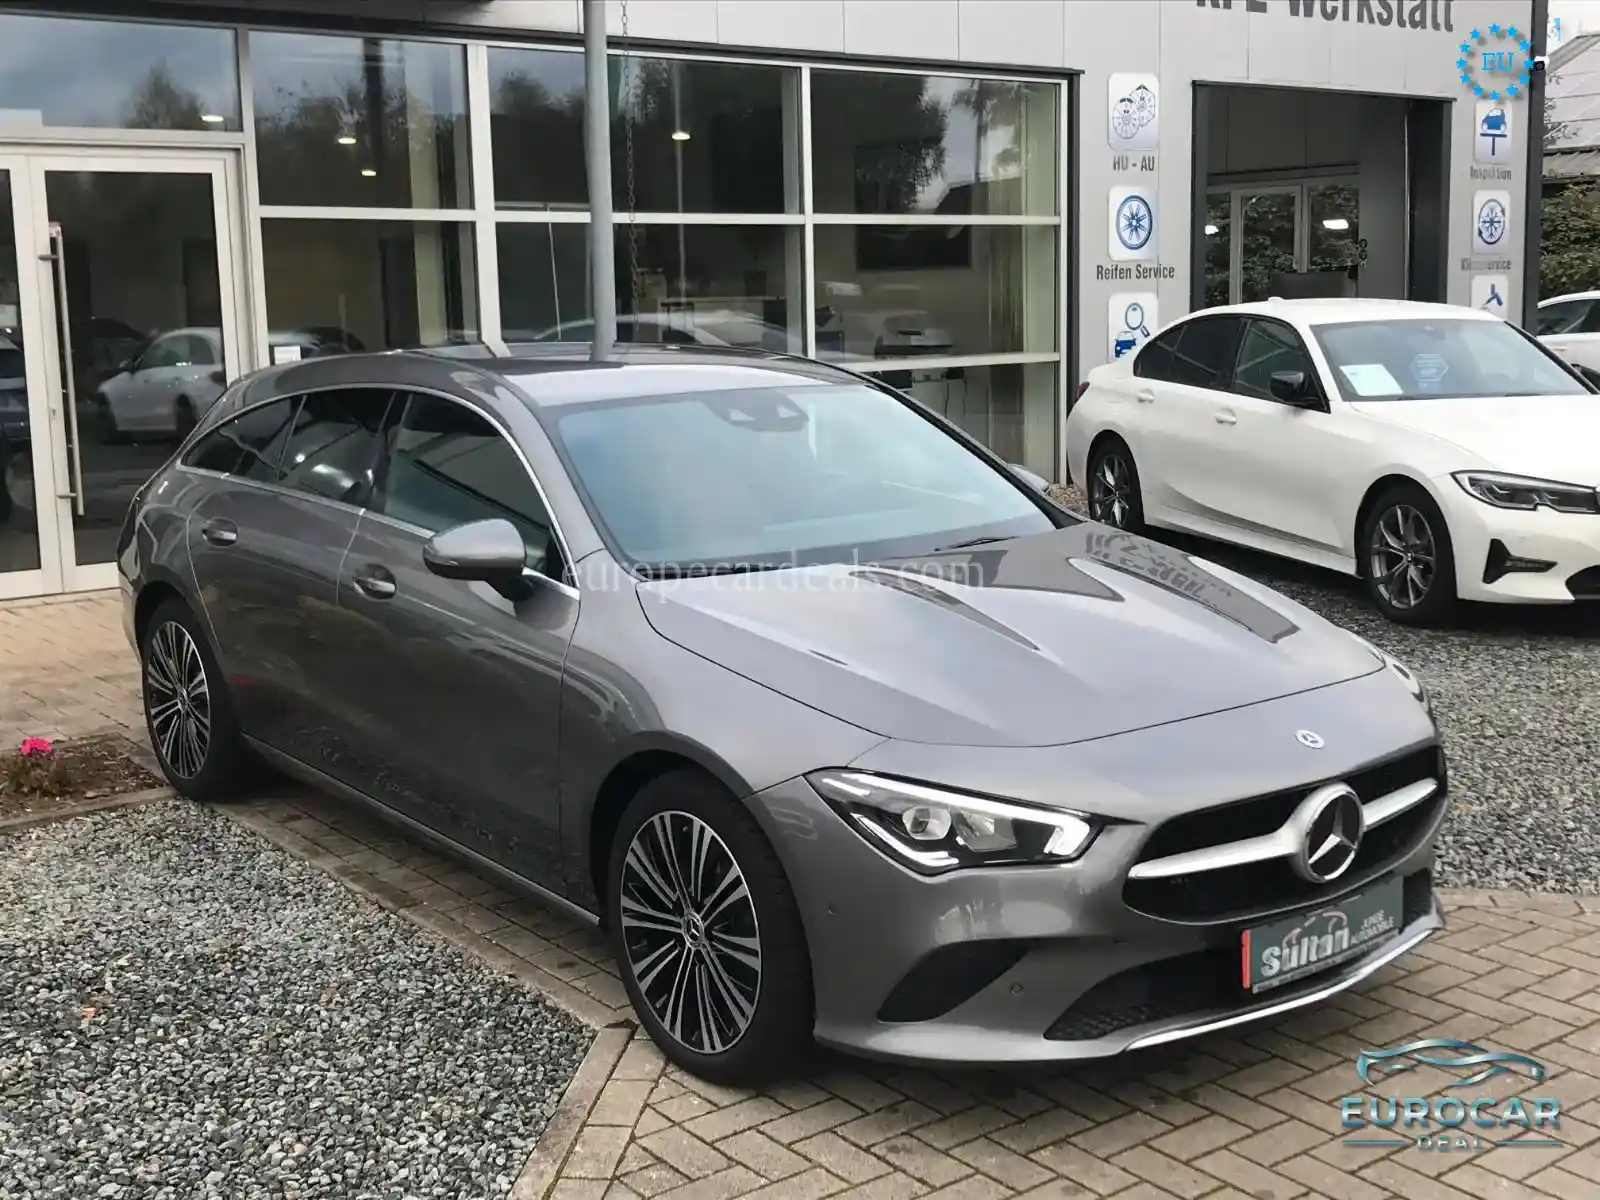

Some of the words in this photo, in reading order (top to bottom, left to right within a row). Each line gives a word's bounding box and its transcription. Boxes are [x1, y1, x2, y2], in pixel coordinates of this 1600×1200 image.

[1113, 155, 1129, 171] HU
[1140, 155, 1155, 172] AU
[1096, 264, 1132, 280] Reifen
[1135, 263, 1175, 279] Service
